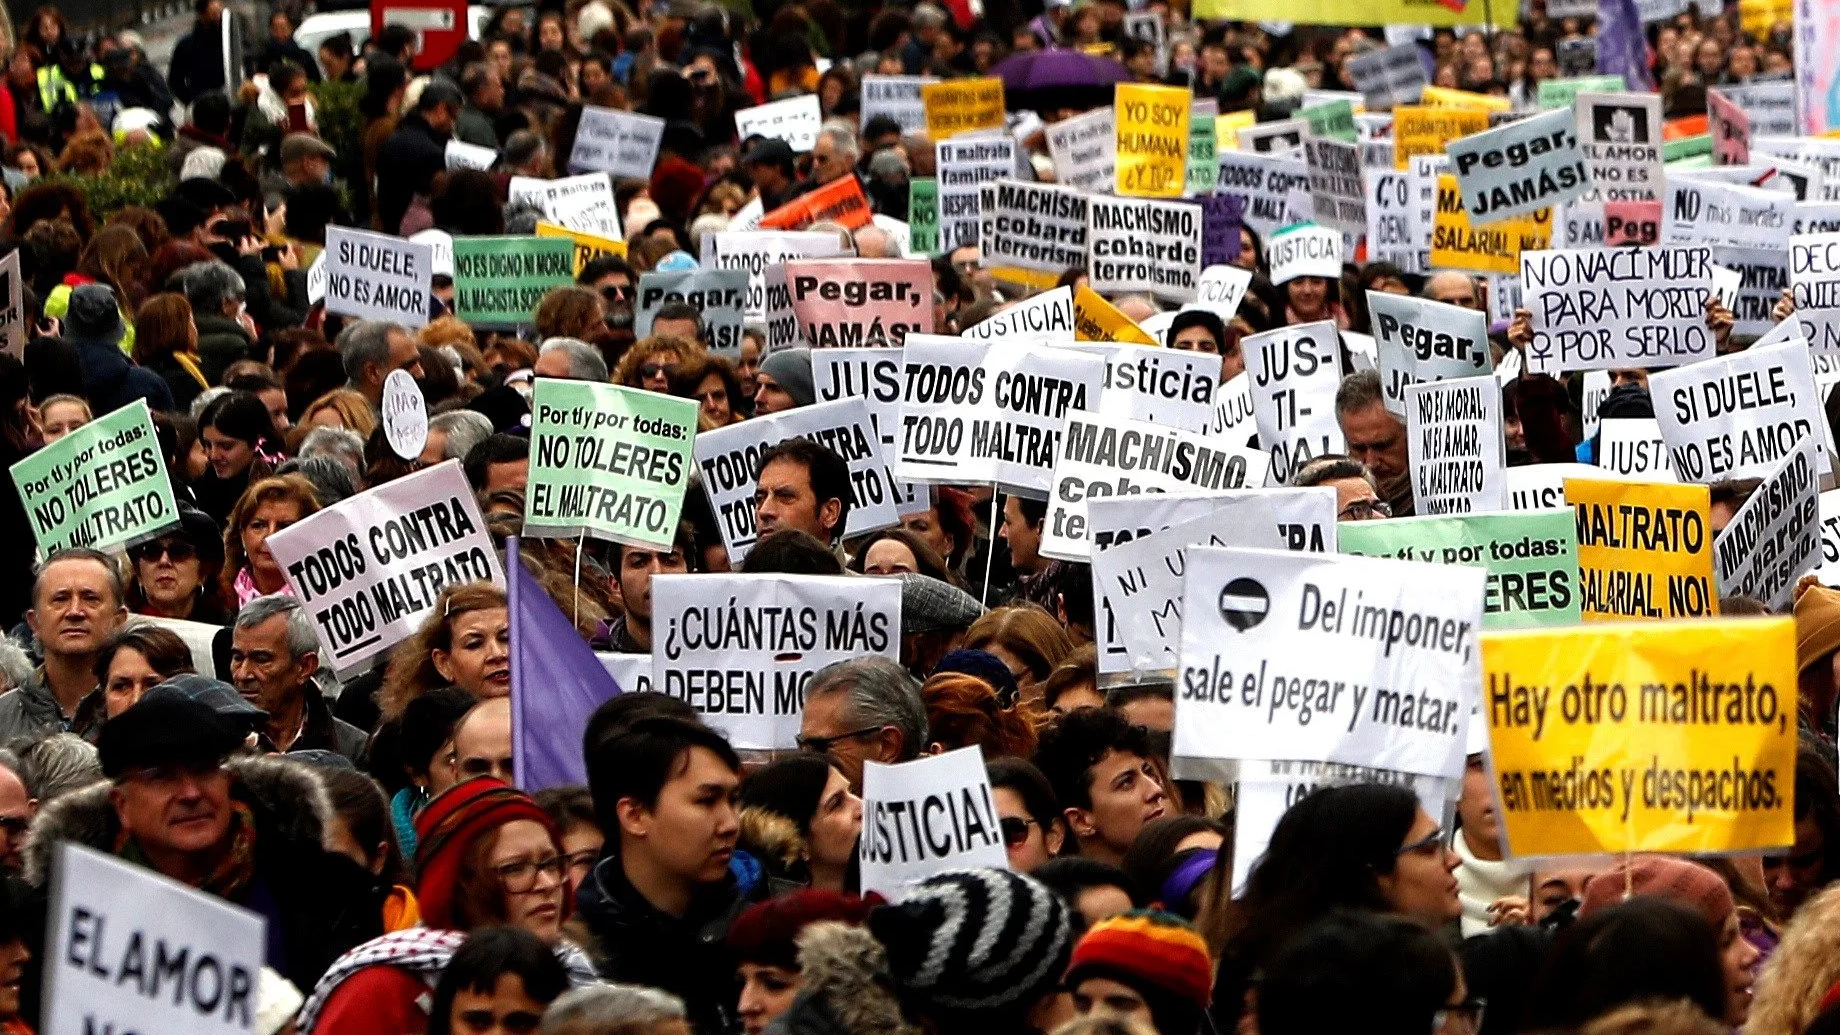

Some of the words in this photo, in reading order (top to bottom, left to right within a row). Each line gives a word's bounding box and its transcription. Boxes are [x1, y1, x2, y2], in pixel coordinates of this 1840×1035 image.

[1125, 101, 1148, 120] YO
[1152, 105, 1183, 128] SOY
[956, 144, 1011, 160] maltrato
[1118, 134, 1182, 157] HUMANA
[1457, 126, 1576, 176] Pegar,
[1606, 146, 1658, 163] AMOR
[1125, 165, 1147, 188] ¿Y
[1219, 165, 1262, 187] TODOS
[1472, 162, 1588, 215] JAMÁS!
[1593, 167, 1621, 181] NO
[1628, 168, 1647, 181] ES
[1674, 188, 1700, 223] NO
[339, 244, 354, 266] SI
[359, 247, 418, 279] DUELE,
[457, 254, 471, 277] NO
[474, 254, 487, 277] ES
[489, 253, 521, 277] DIGNO
[523, 253, 535, 277] NI
[537, 252, 573, 276] MORAL
[1093, 234, 1197, 265] cobarde
[1524, 255, 1570, 289] NO
[1575, 244, 1643, 284] NACÍ
[1793, 244, 1821, 274] DE
[328, 273, 349, 297] NO
[355, 278, 370, 302] ES
[374, 282, 427, 317] AMOR.
[795, 275, 921, 309] Pegar,
[1093, 262, 1197, 289] terrorismo.
[457, 288, 471, 311] AL
[472, 287, 519, 312] MACHISTA
[1541, 290, 1617, 328] PARA
[1627, 287, 1710, 321] MORIR
[800, 317, 922, 348] JAMÁS!
[1377, 311, 1486, 370] Pegar,
[1561, 331, 1616, 365] POR
[1626, 324, 1706, 358] SERLO
[904, 362, 984, 405] TODOS
[1673, 387, 1700, 426] SI
[1704, 365, 1797, 421] DUELE,
[537, 402, 570, 425] Por
[593, 410, 629, 436] por
[630, 414, 688, 441] todas:
[1418, 391, 1434, 424] NO
[1435, 391, 1444, 421] ES
[903, 417, 962, 457] TODO
[1422, 426, 1432, 460] NI
[1434, 425, 1442, 459] ES
[1443, 424, 1482, 459] AMAR,
[23, 471, 51, 501] Por
[71, 442, 97, 475] por
[96, 421, 150, 456] todas:
[537, 435, 570, 470] NO
[573, 435, 684, 487] TOLERES
[1419, 465, 1428, 497] EL
[1430, 460, 1484, 497] MALTRATO
[1673, 442, 1704, 482] NO
[1707, 437, 1734, 474] ES
[33, 500, 67, 534] NO
[66, 447, 160, 517] TOLERES
[531, 489, 557, 519] EL
[557, 490, 671, 537] MALTRATO.
[288, 531, 367, 596] TODOS
[368, 495, 477, 563] CONTRA
[1443, 541, 1487, 564] por
[1490, 534, 1569, 560] todas:
[372, 547, 493, 626] MALTRATO
[1117, 565, 1148, 598] NI
[1667, 573, 1712, 617] NO!
[664, 596, 818, 659] ¿CUÁNTAS
[826, 598, 890, 653] MÁS
[1298, 581, 1344, 633] Del
[1352, 595, 1472, 663] imponer,
[1182, 654, 1234, 705] sale
[1242, 663, 1267, 709] el
[1268, 673, 1344, 730] pegar
[1371, 686, 1460, 737] matar.
[1490, 672, 1549, 742] Hay
[1561, 673, 1628, 724] otro
[1638, 669, 1788, 733] maltrato,
[1501, 771, 1529, 811] en
[1532, 765, 1614, 815] medios
[1642, 757, 1784, 823] despachos.
[116, 930, 257, 1027] AMOR
